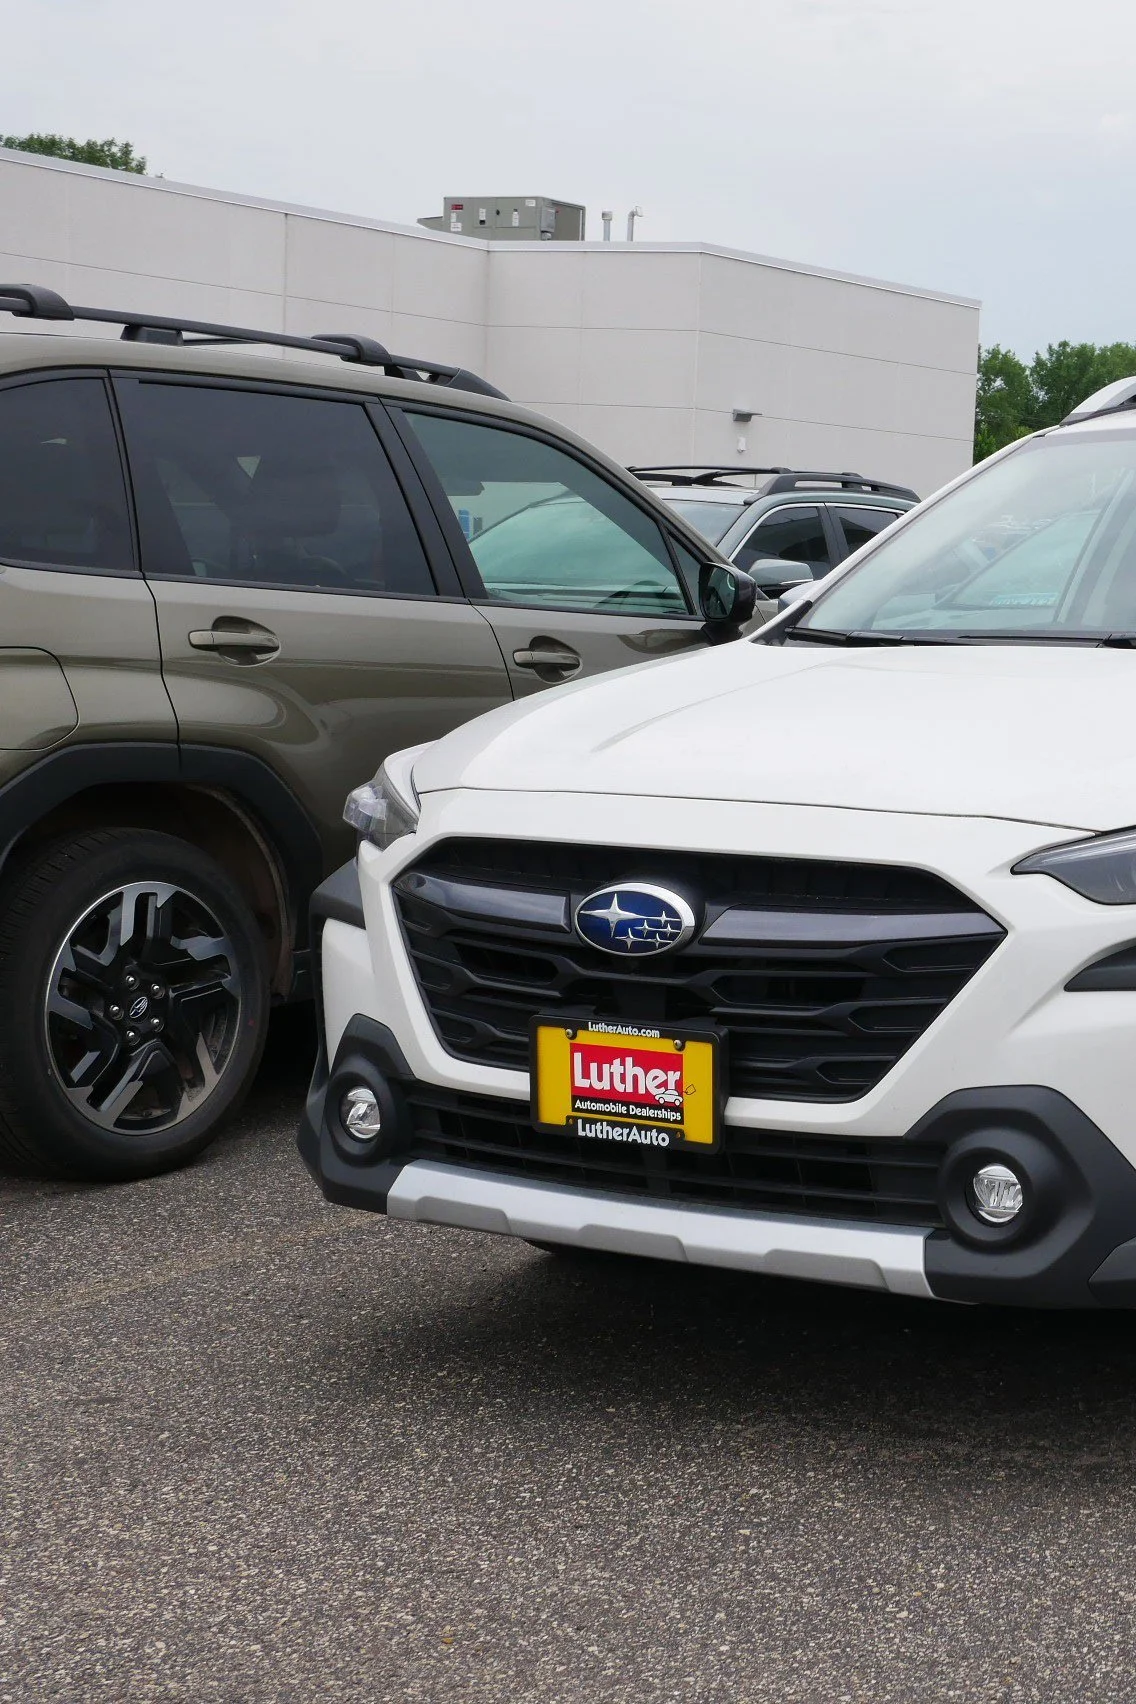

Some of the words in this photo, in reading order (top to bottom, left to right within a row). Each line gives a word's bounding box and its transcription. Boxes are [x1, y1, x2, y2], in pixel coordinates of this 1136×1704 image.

[588, 1021, 660, 1038] LutherAuto.com
[573, 1052, 681, 1094] Luther
[574, 1099, 627, 1114] Automobile
[629, 1105, 681, 1121] Dealerships
[577, 1119, 670, 1147] LutherAuto
